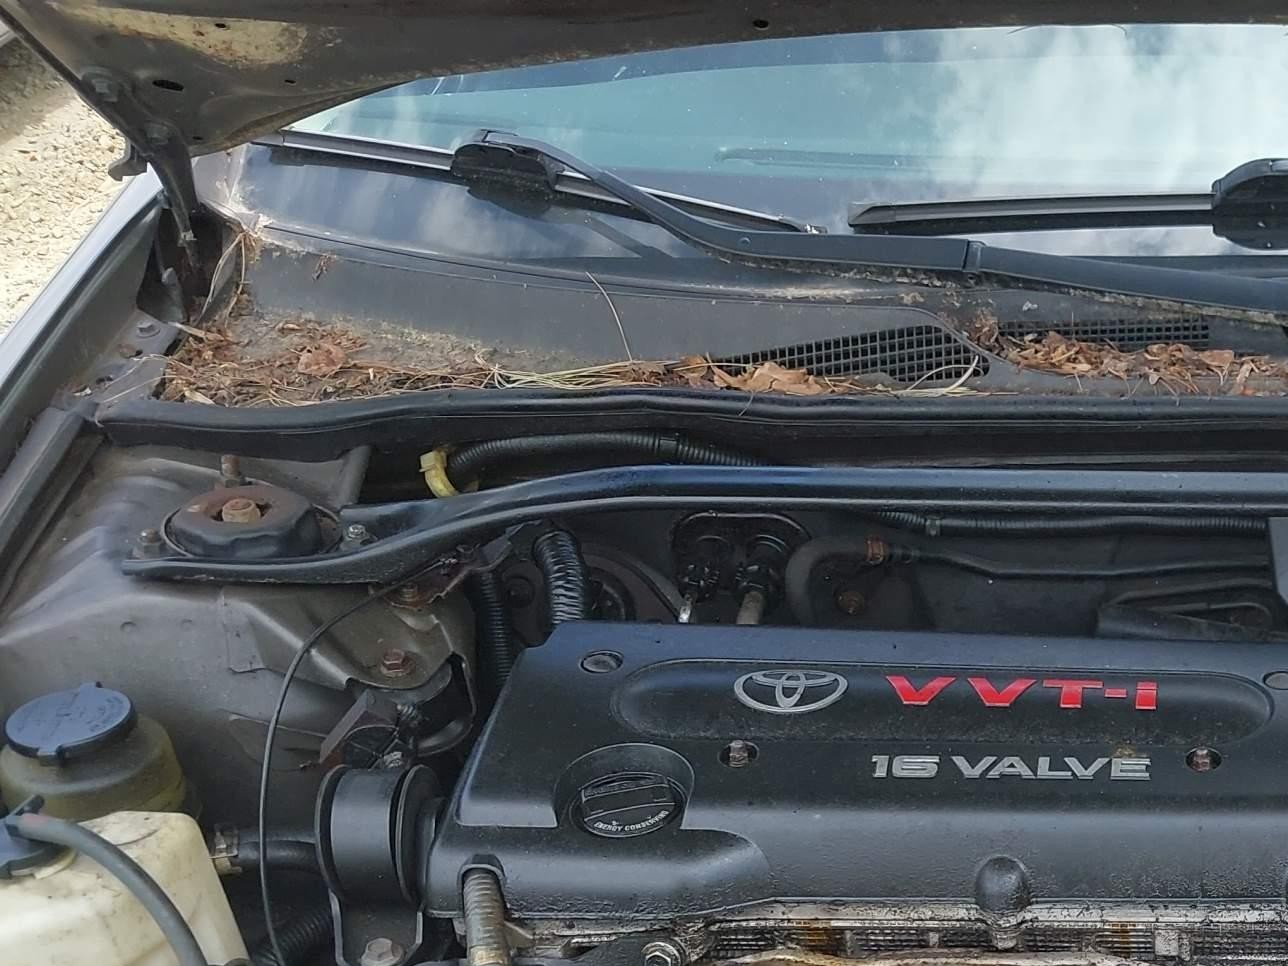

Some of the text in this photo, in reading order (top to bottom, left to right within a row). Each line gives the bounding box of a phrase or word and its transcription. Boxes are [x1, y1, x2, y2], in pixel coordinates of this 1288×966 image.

[871, 755, 1151, 781] 16 VALVE
[594, 810, 670, 832] ENERGY CONSERVING
